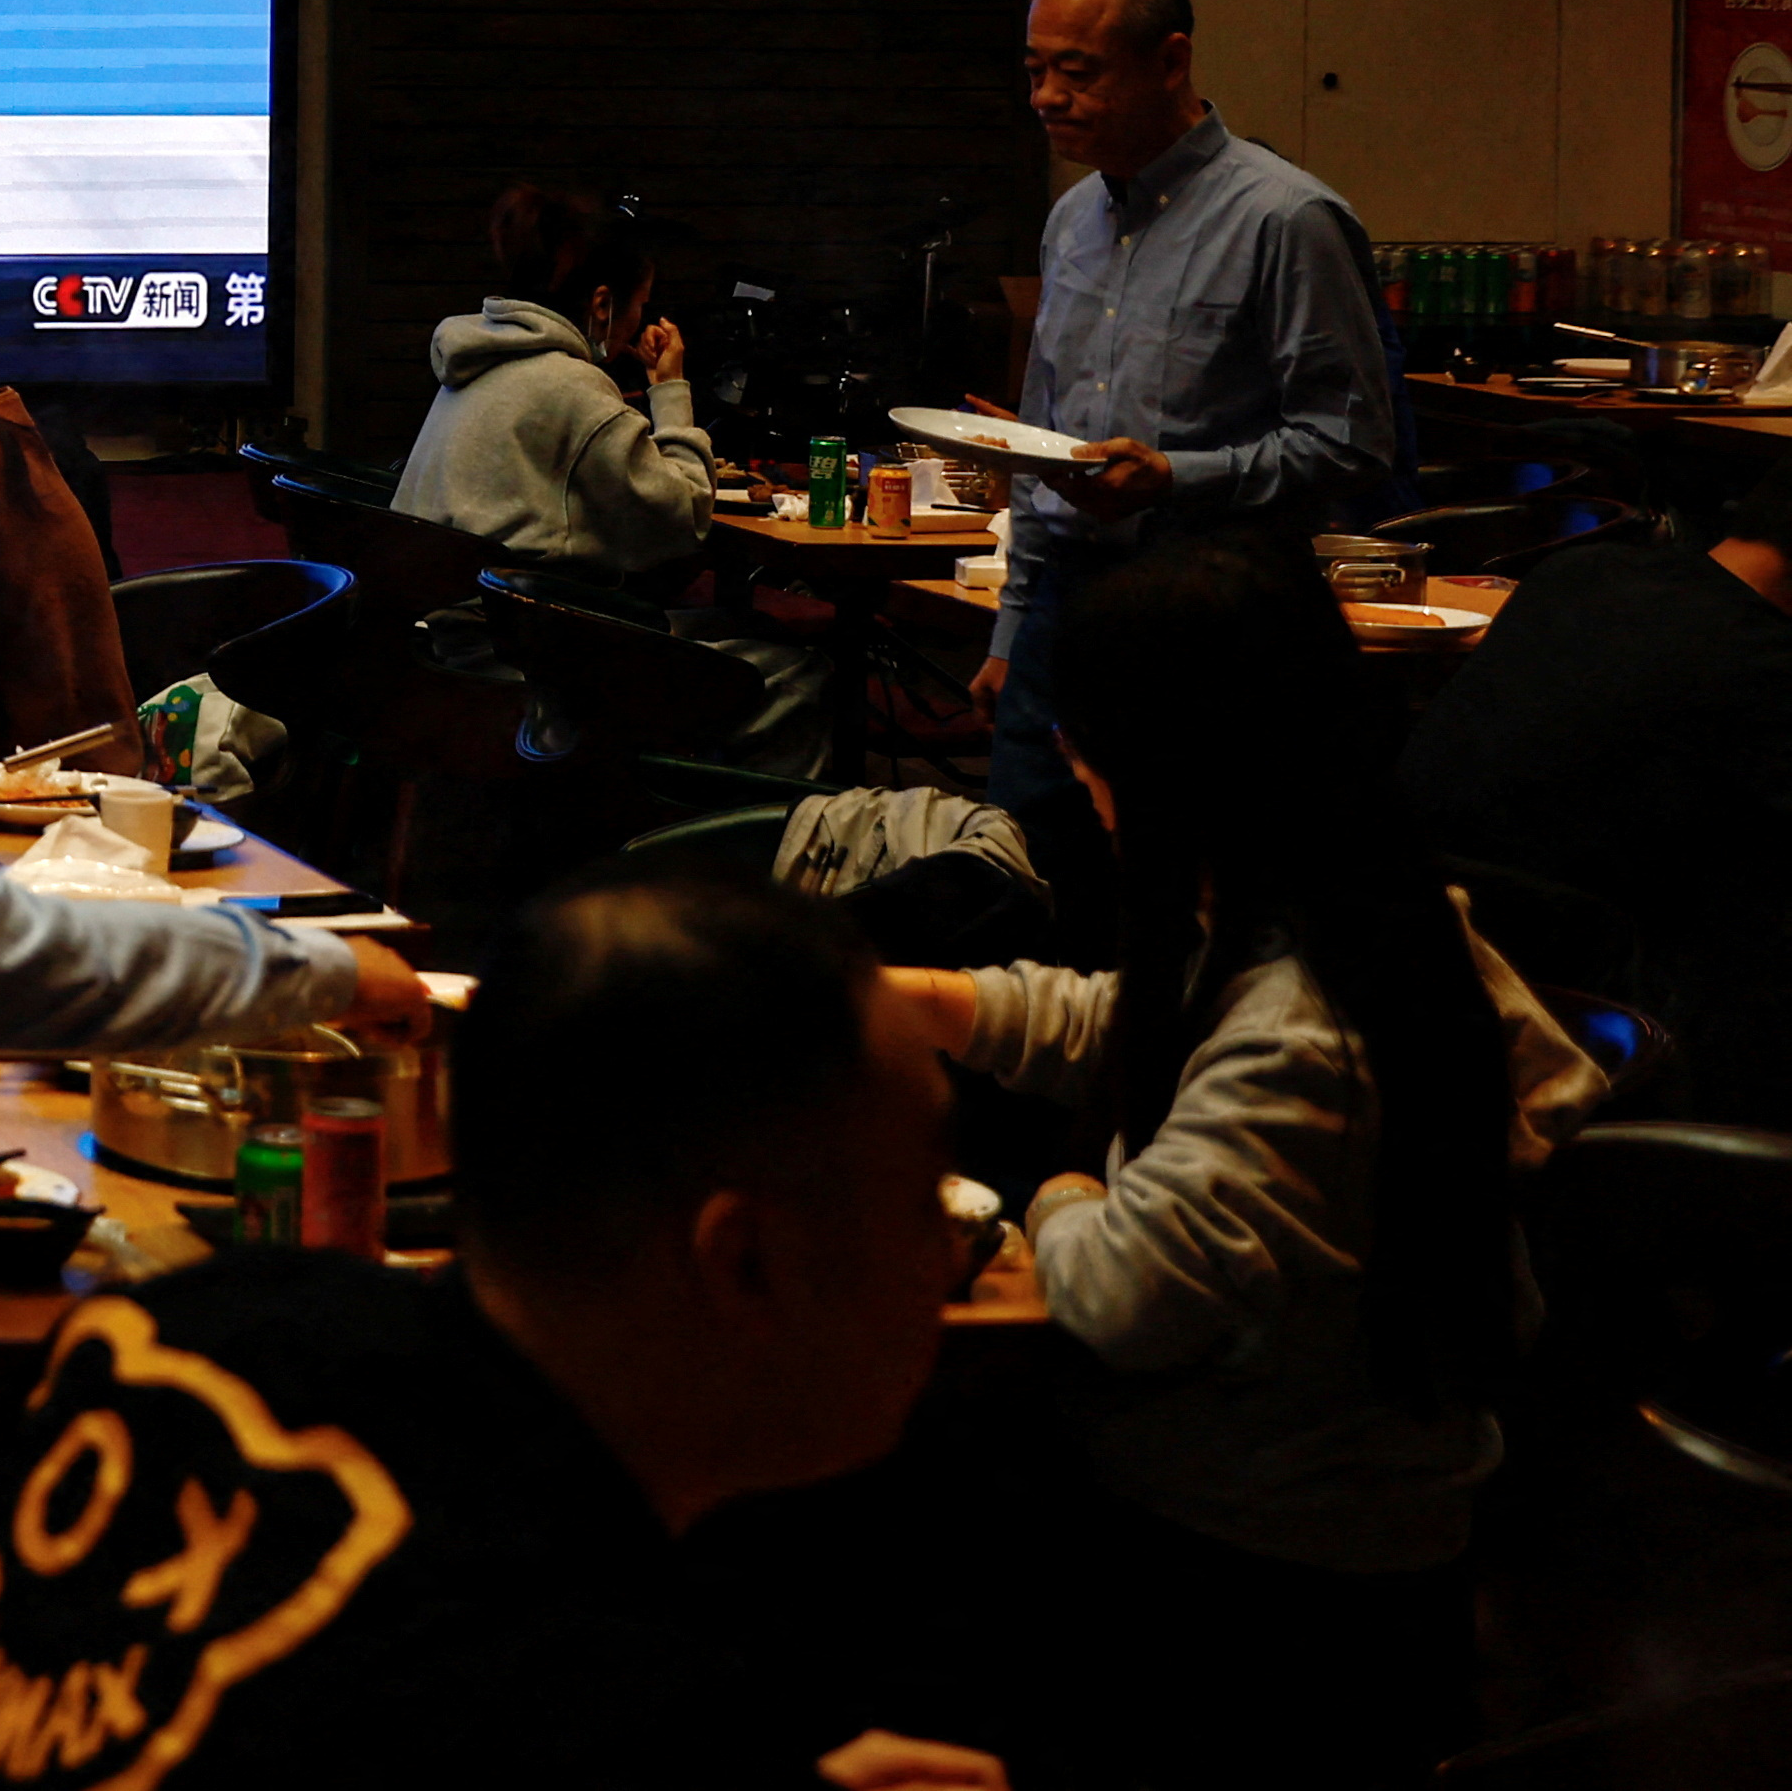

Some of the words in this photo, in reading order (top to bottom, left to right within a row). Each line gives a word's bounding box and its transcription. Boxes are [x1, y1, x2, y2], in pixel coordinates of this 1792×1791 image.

[32, 273, 133, 317] CCTV
[143, 280, 200, 318] 新闻
[225, 272, 266, 327] 第
